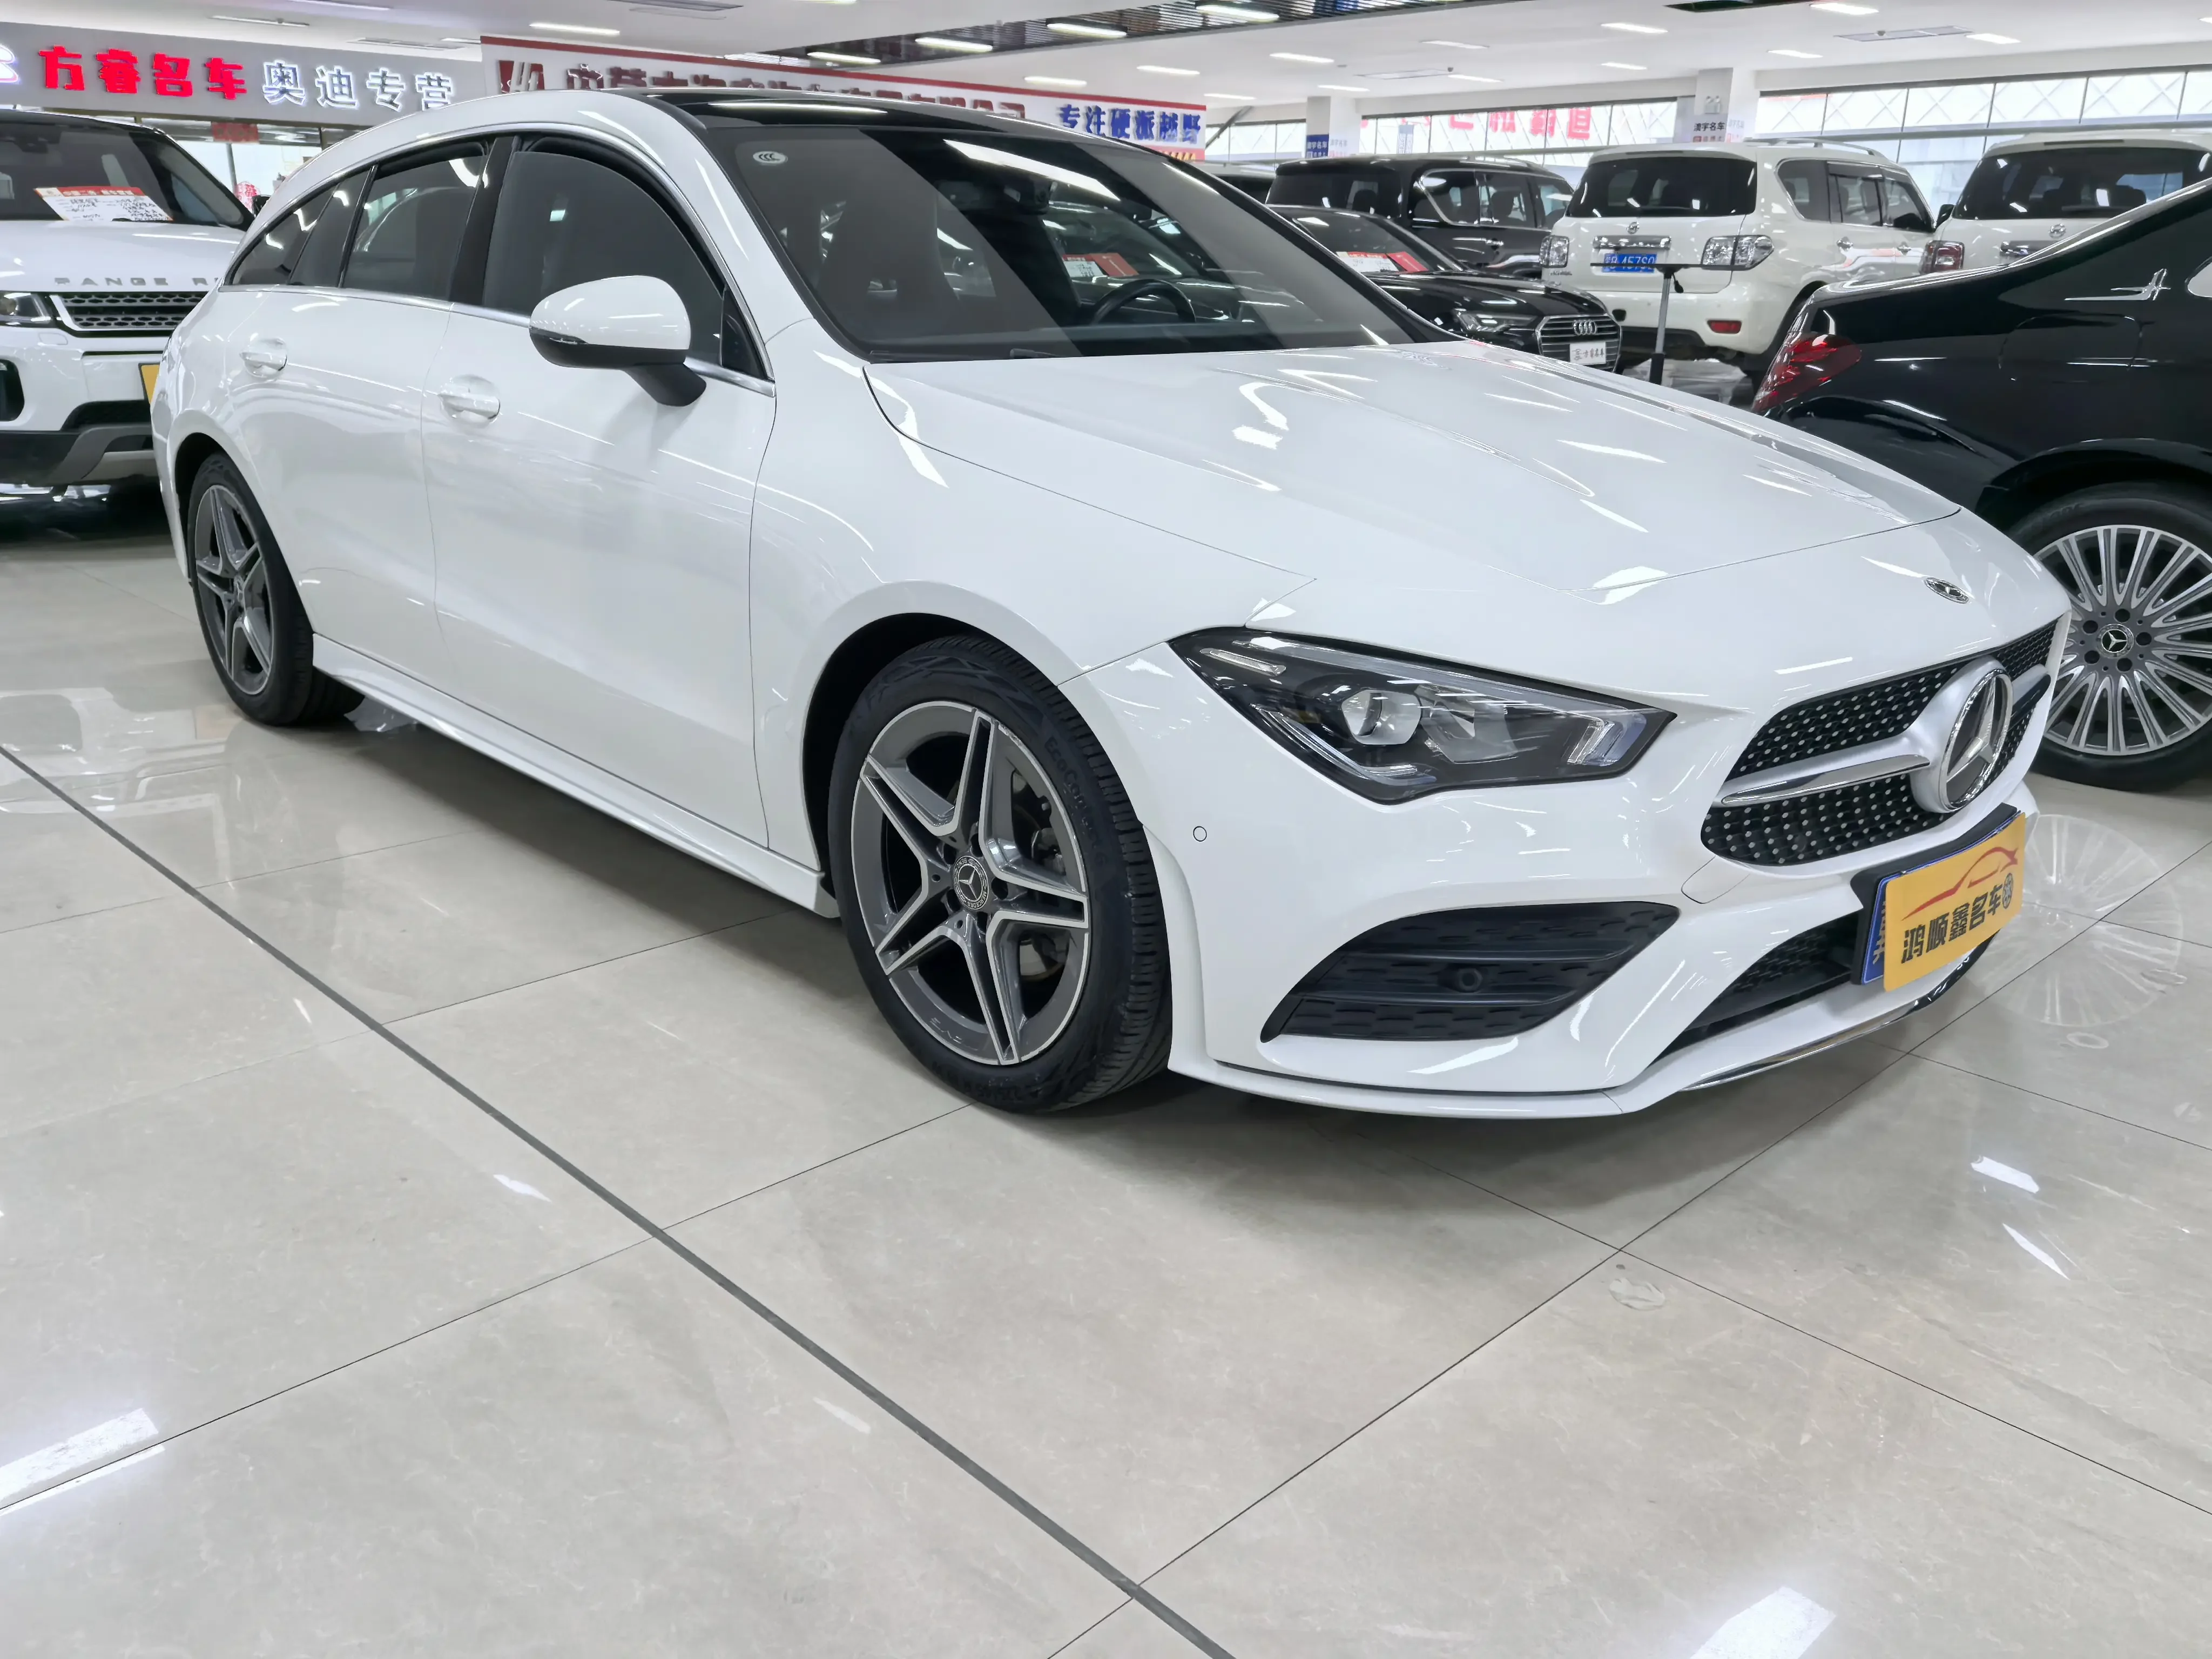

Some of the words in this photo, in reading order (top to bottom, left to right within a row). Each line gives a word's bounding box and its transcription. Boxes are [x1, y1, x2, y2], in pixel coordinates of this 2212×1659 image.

[39, 45, 247, 100] 方睿名车
[262, 59, 454, 112] 奥迪专营
[54, 277, 168, 286] RANGE
[1901, 884, 2003, 964] 鸿顺鑫名车
